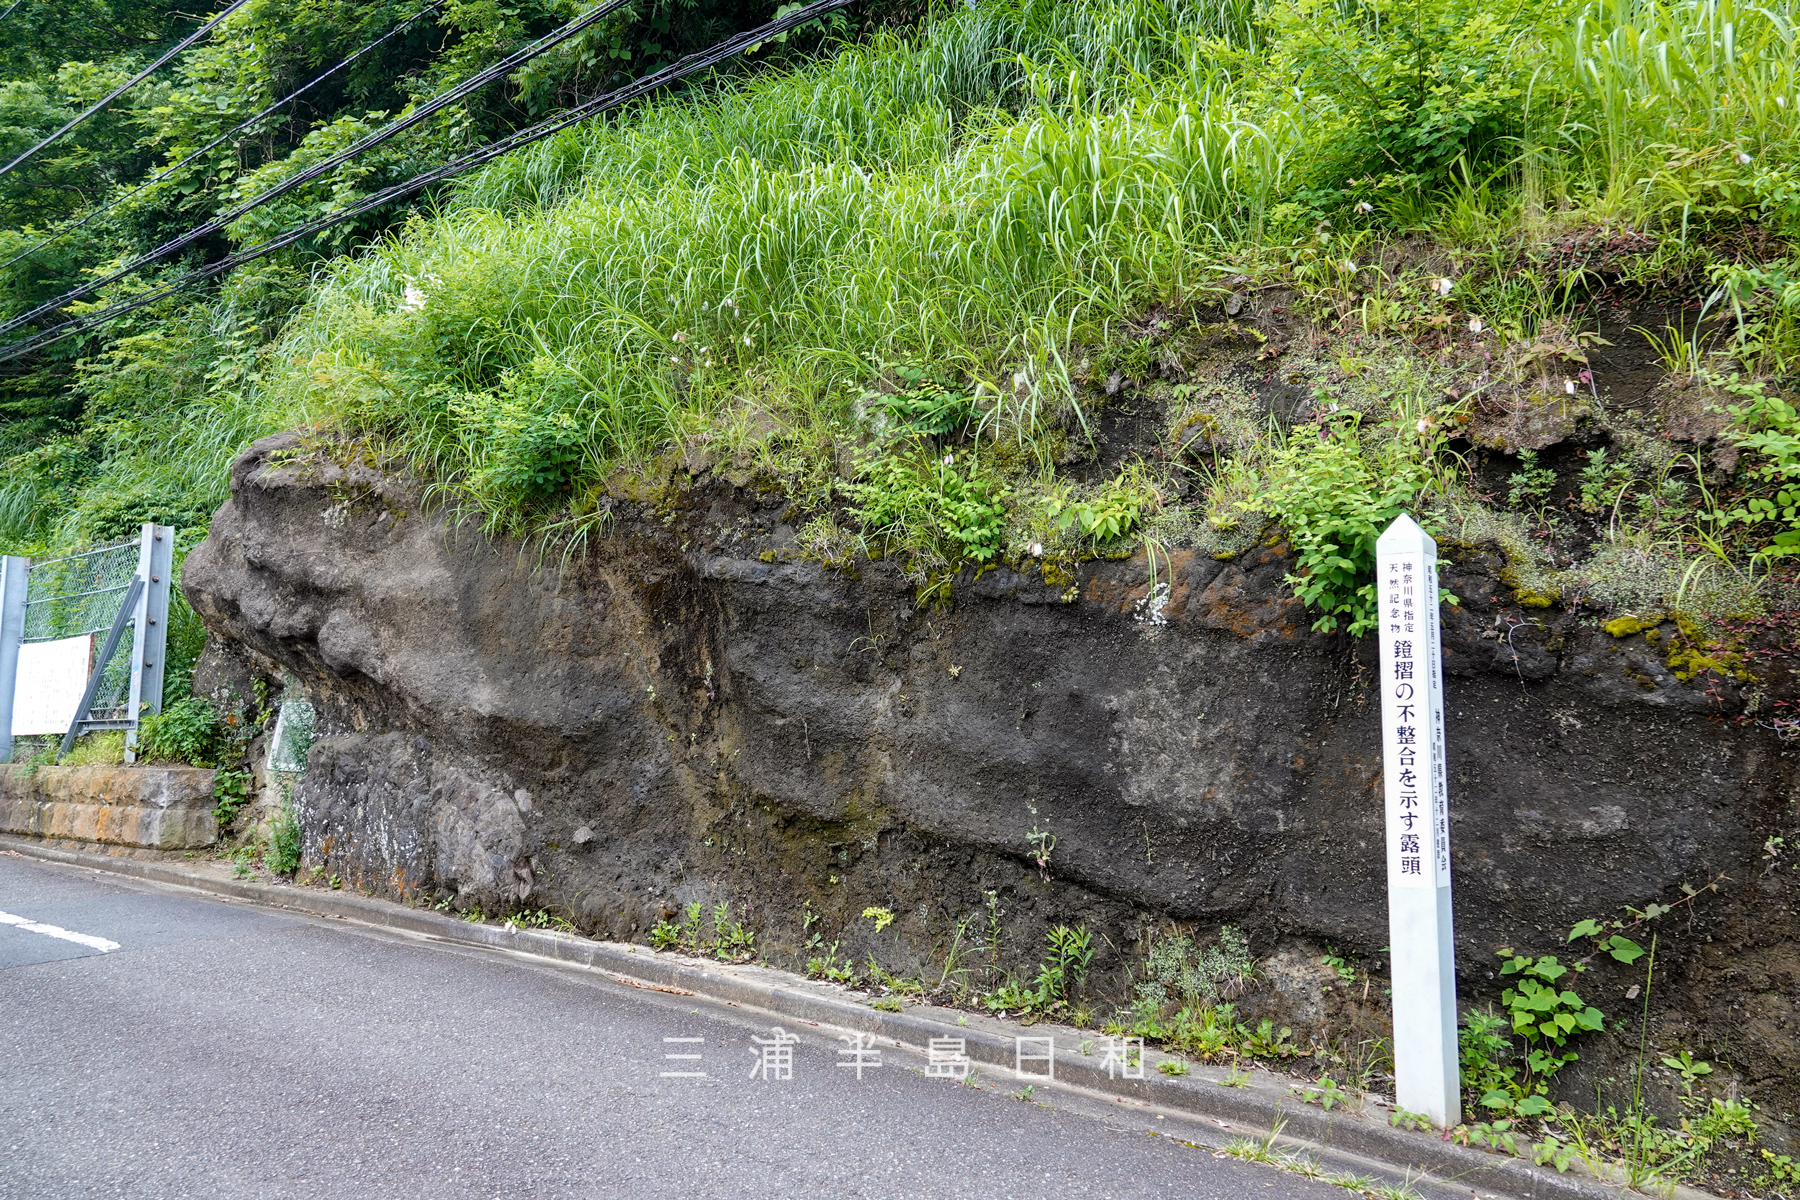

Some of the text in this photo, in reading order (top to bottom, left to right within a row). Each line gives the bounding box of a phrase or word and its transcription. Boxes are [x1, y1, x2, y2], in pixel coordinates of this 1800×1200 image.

[1389, 563, 1400, 634] 天然記念物
[1403, 562, 1414, 633] 神奈川県指定
[1393, 640, 1421, 875] 鐙摺の不整合を示す露頭
